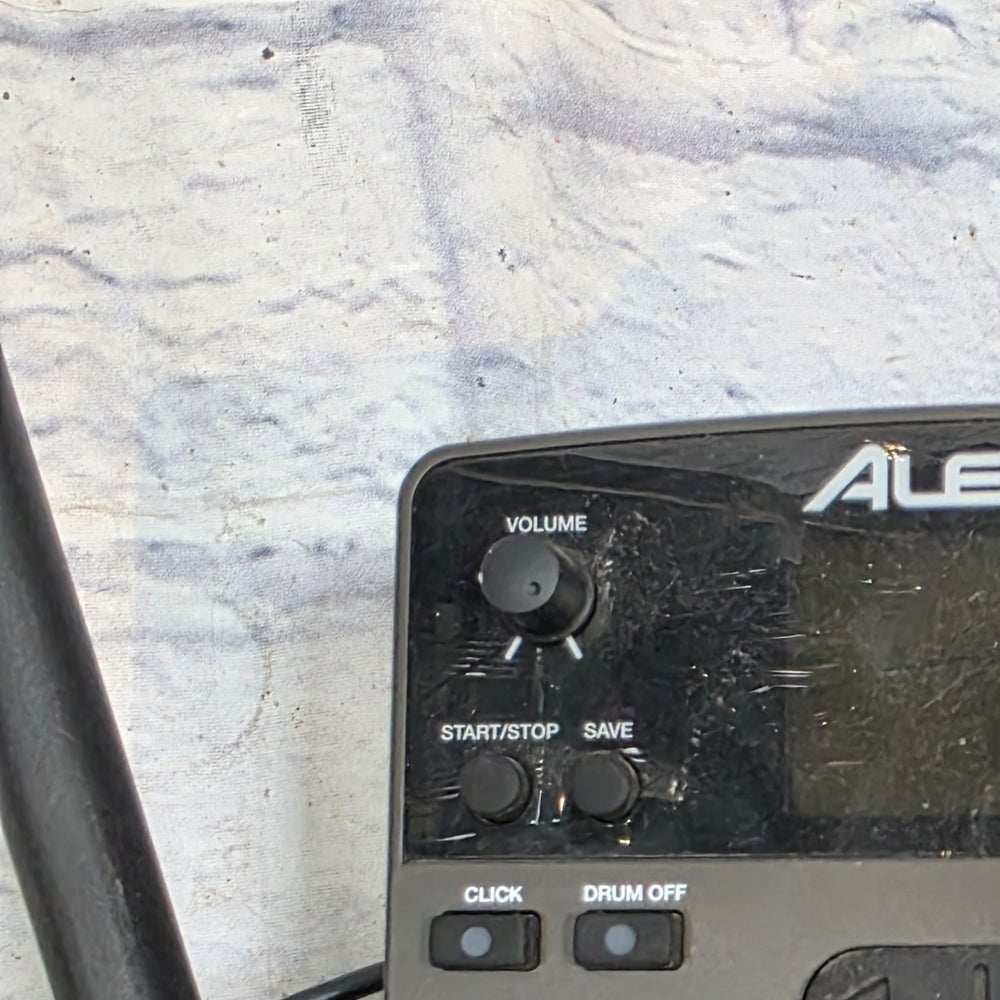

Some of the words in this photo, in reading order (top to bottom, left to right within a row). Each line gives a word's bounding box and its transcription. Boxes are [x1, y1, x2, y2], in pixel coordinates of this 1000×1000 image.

[506, 513, 588, 534] VOLUME
[440, 722, 560, 742] START/STOP
[583, 721, 634, 740] SAVE
[463, 885, 524, 904] CLICK
[583, 884, 644, 903] DRUM
[648, 883, 688, 902] OFF
